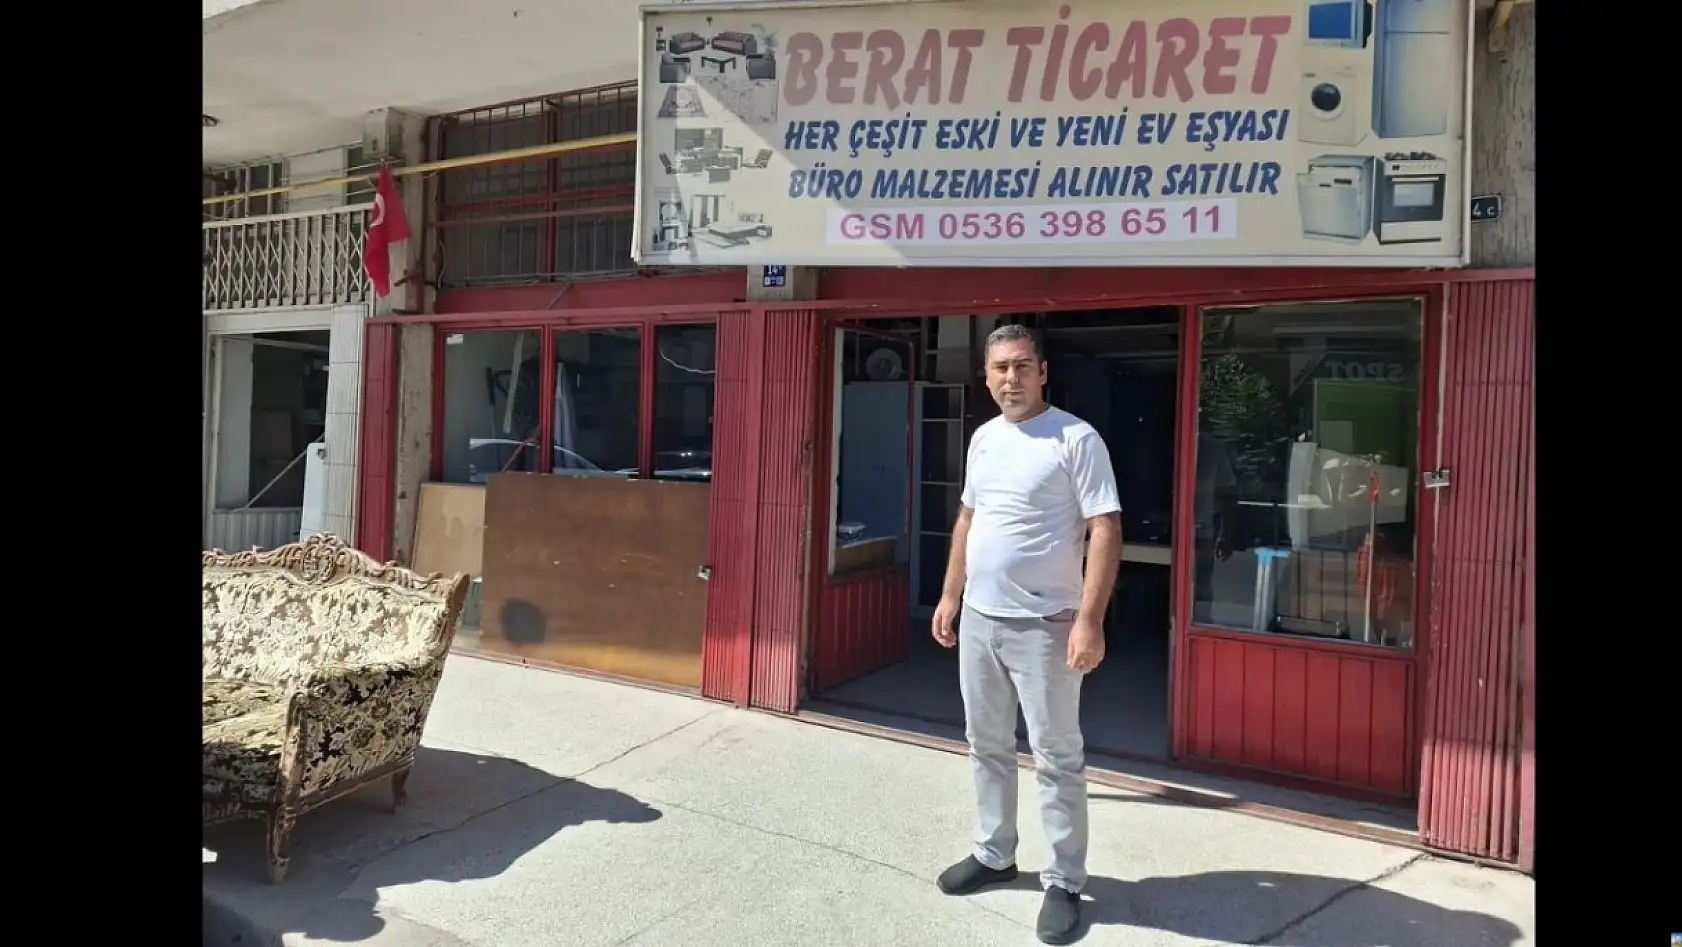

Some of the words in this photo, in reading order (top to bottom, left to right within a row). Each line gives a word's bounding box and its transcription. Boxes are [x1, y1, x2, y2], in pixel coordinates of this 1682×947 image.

[783, 28, 986, 109] BERAT
[1006, 4, 1291, 104] TİCARET
[784, 119, 840, 151] HER
[848, 112, 927, 157] ÇEŞİT
[935, 111, 1001, 149] ESKİ
[1010, 117, 1047, 148] VE
[1056, 106, 1128, 147] YENİ
[1137, 112, 1177, 145] EV
[1186, 109, 1290, 151] EŞYASI
[788, 163, 863, 199] BÜRO
[870, 160, 1041, 199] MALZEMESİ
[1047, 166, 1152, 199] ALINIR
[1161, 162, 1281, 196] SATILIR
[840, 213, 925, 240] GSM
[938, 212, 1026, 239] 0536
[1040, 210, 1106, 237] 398
[1121, 206, 1167, 235] 65
[1182, 205, 1220, 233] 11
